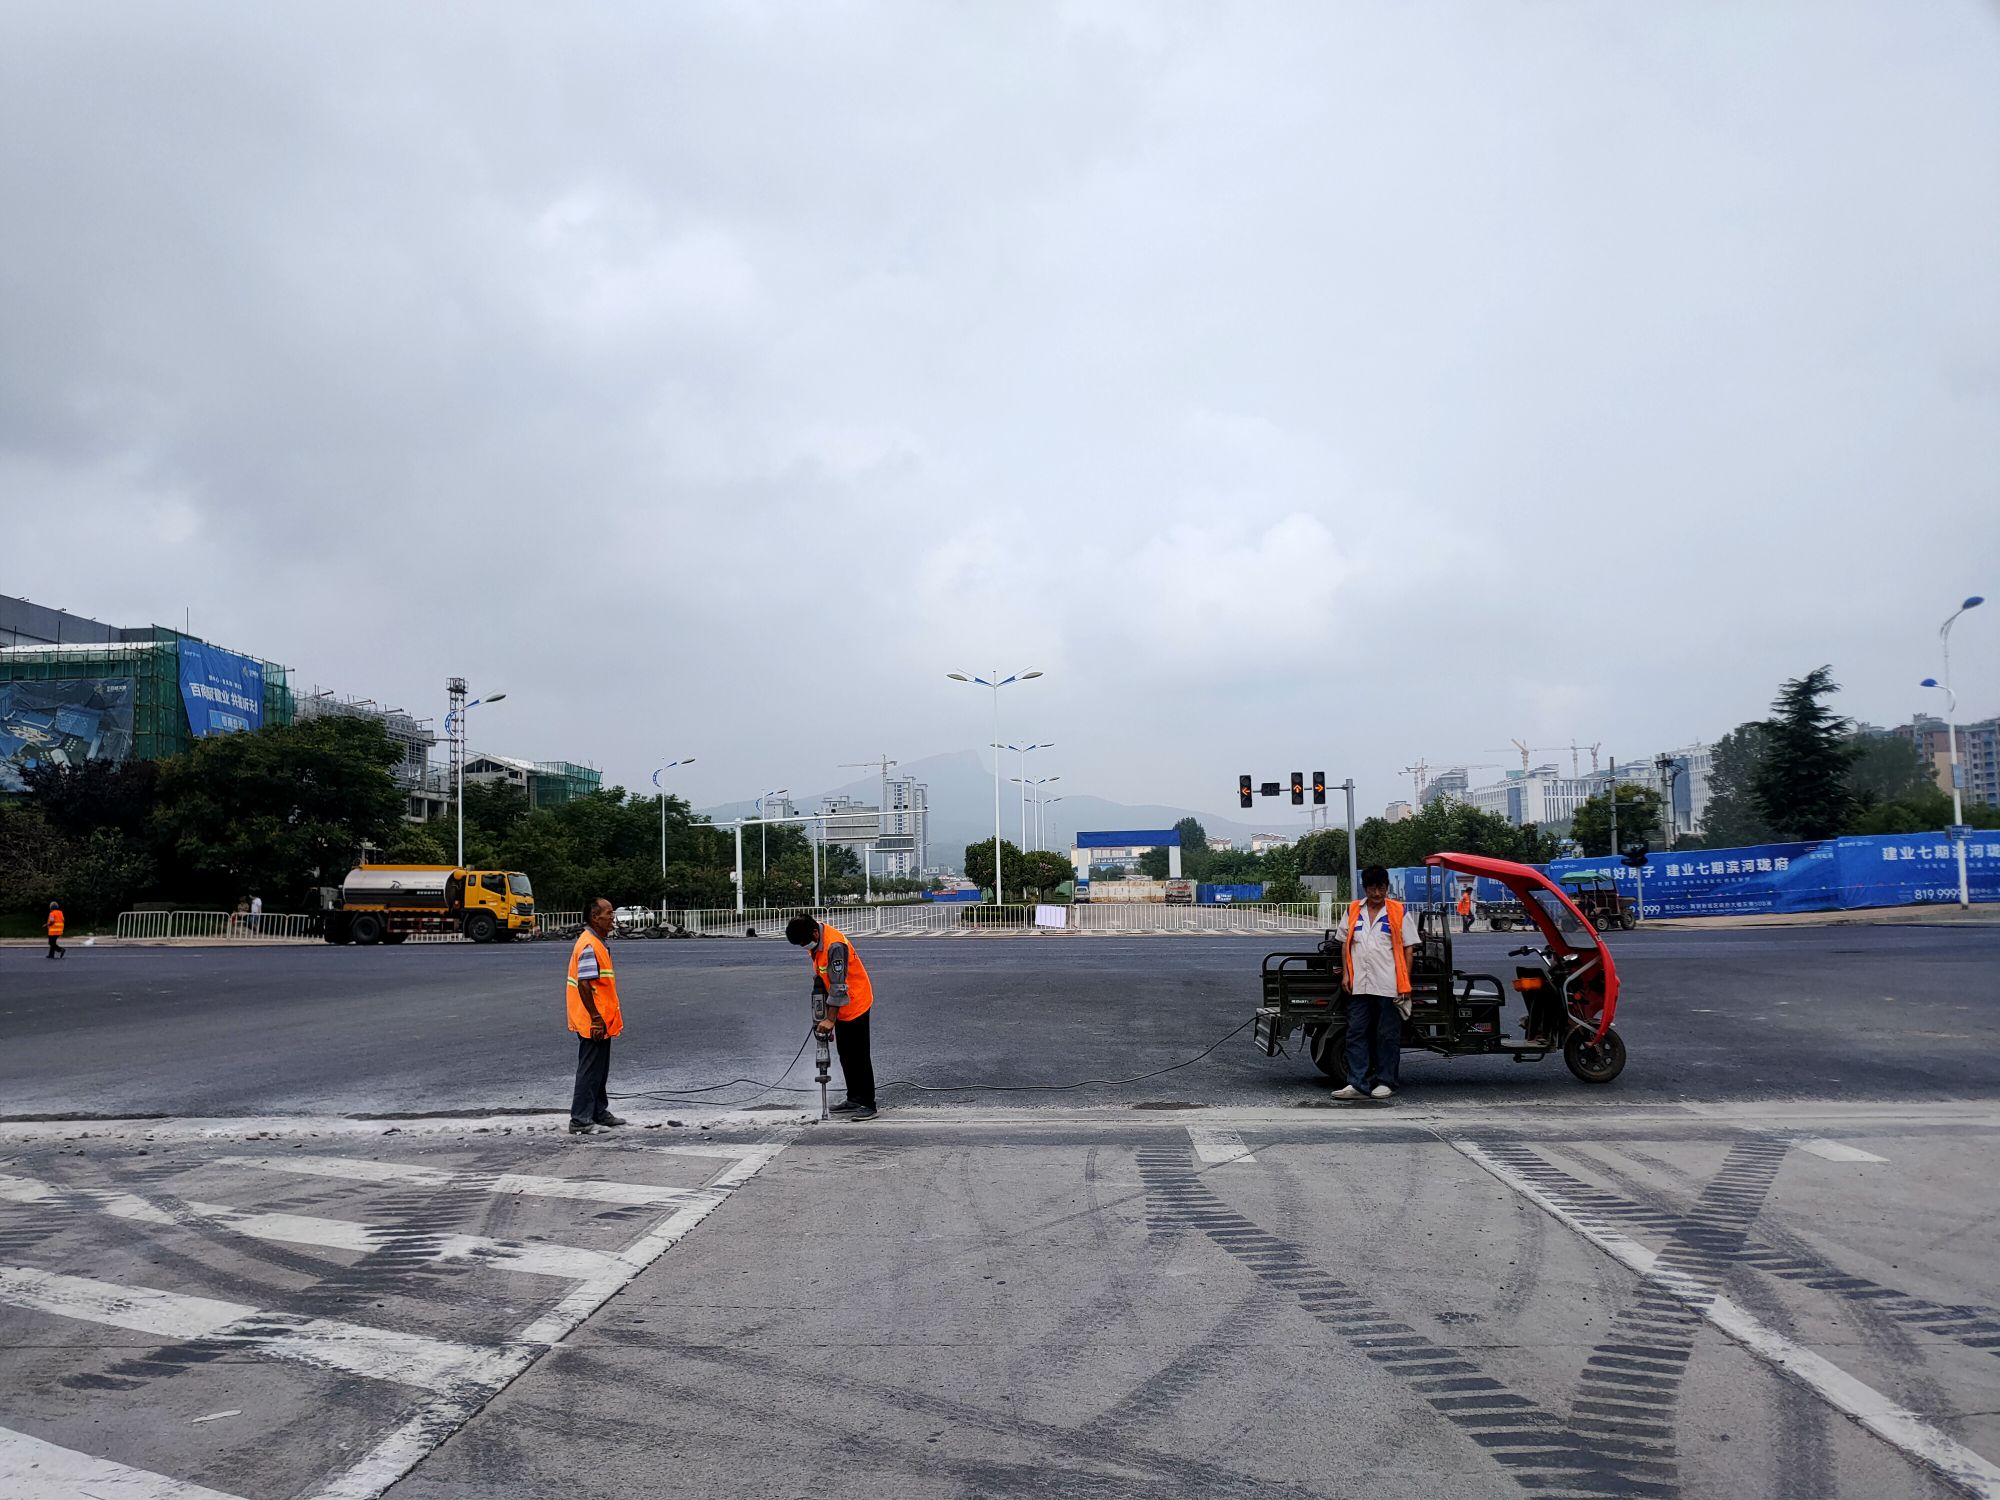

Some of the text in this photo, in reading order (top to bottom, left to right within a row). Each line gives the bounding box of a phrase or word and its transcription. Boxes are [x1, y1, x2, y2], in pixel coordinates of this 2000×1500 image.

[1586, 857, 1789, 880] 钢好房子 建业七期滨河珑府
[1914, 888, 1934, 900] 819
[1637, 905, 1661, 916] 999
